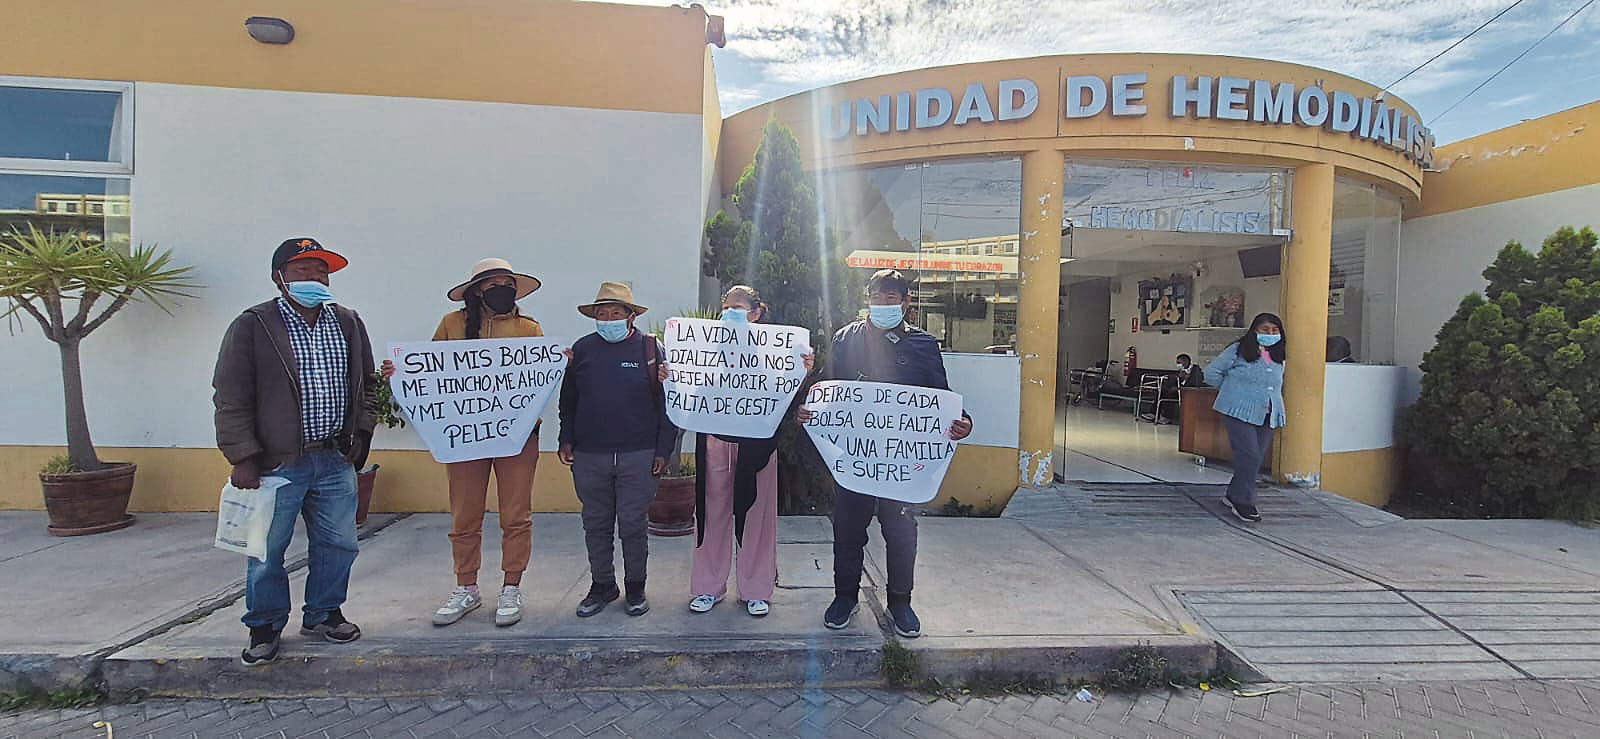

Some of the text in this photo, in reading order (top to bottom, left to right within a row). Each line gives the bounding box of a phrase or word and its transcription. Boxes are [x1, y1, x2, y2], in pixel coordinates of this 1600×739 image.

[821, 78, 1040, 140] UNIDAD
[1066, 73, 1148, 119] DE
[702, 326, 739, 345] VIDA
[748, 330, 767, 346] NO
[773, 332, 795, 349] SE
[453, 350, 493, 371] MIS
[500, 344, 563, 367] BOLSAS
[670, 349, 796, 371] DIALIZA: NO NOS
[402, 378, 429, 398] ME
[669, 369, 714, 387] DEJEN
[719, 373, 768, 391] MORIR
[419, 401, 445, 422] MI
[453, 395, 504, 415] VIDA
[667, 390, 710, 415] FALTA
[714, 397, 733, 415] DE
[873, 388, 892, 404] DE
[896, 391, 940, 410] CADA
[808, 410, 941, 434] BOLSA QUE FALTA
[847, 437, 878, 459] UNA
[886, 438, 954, 461] FAMILIA
